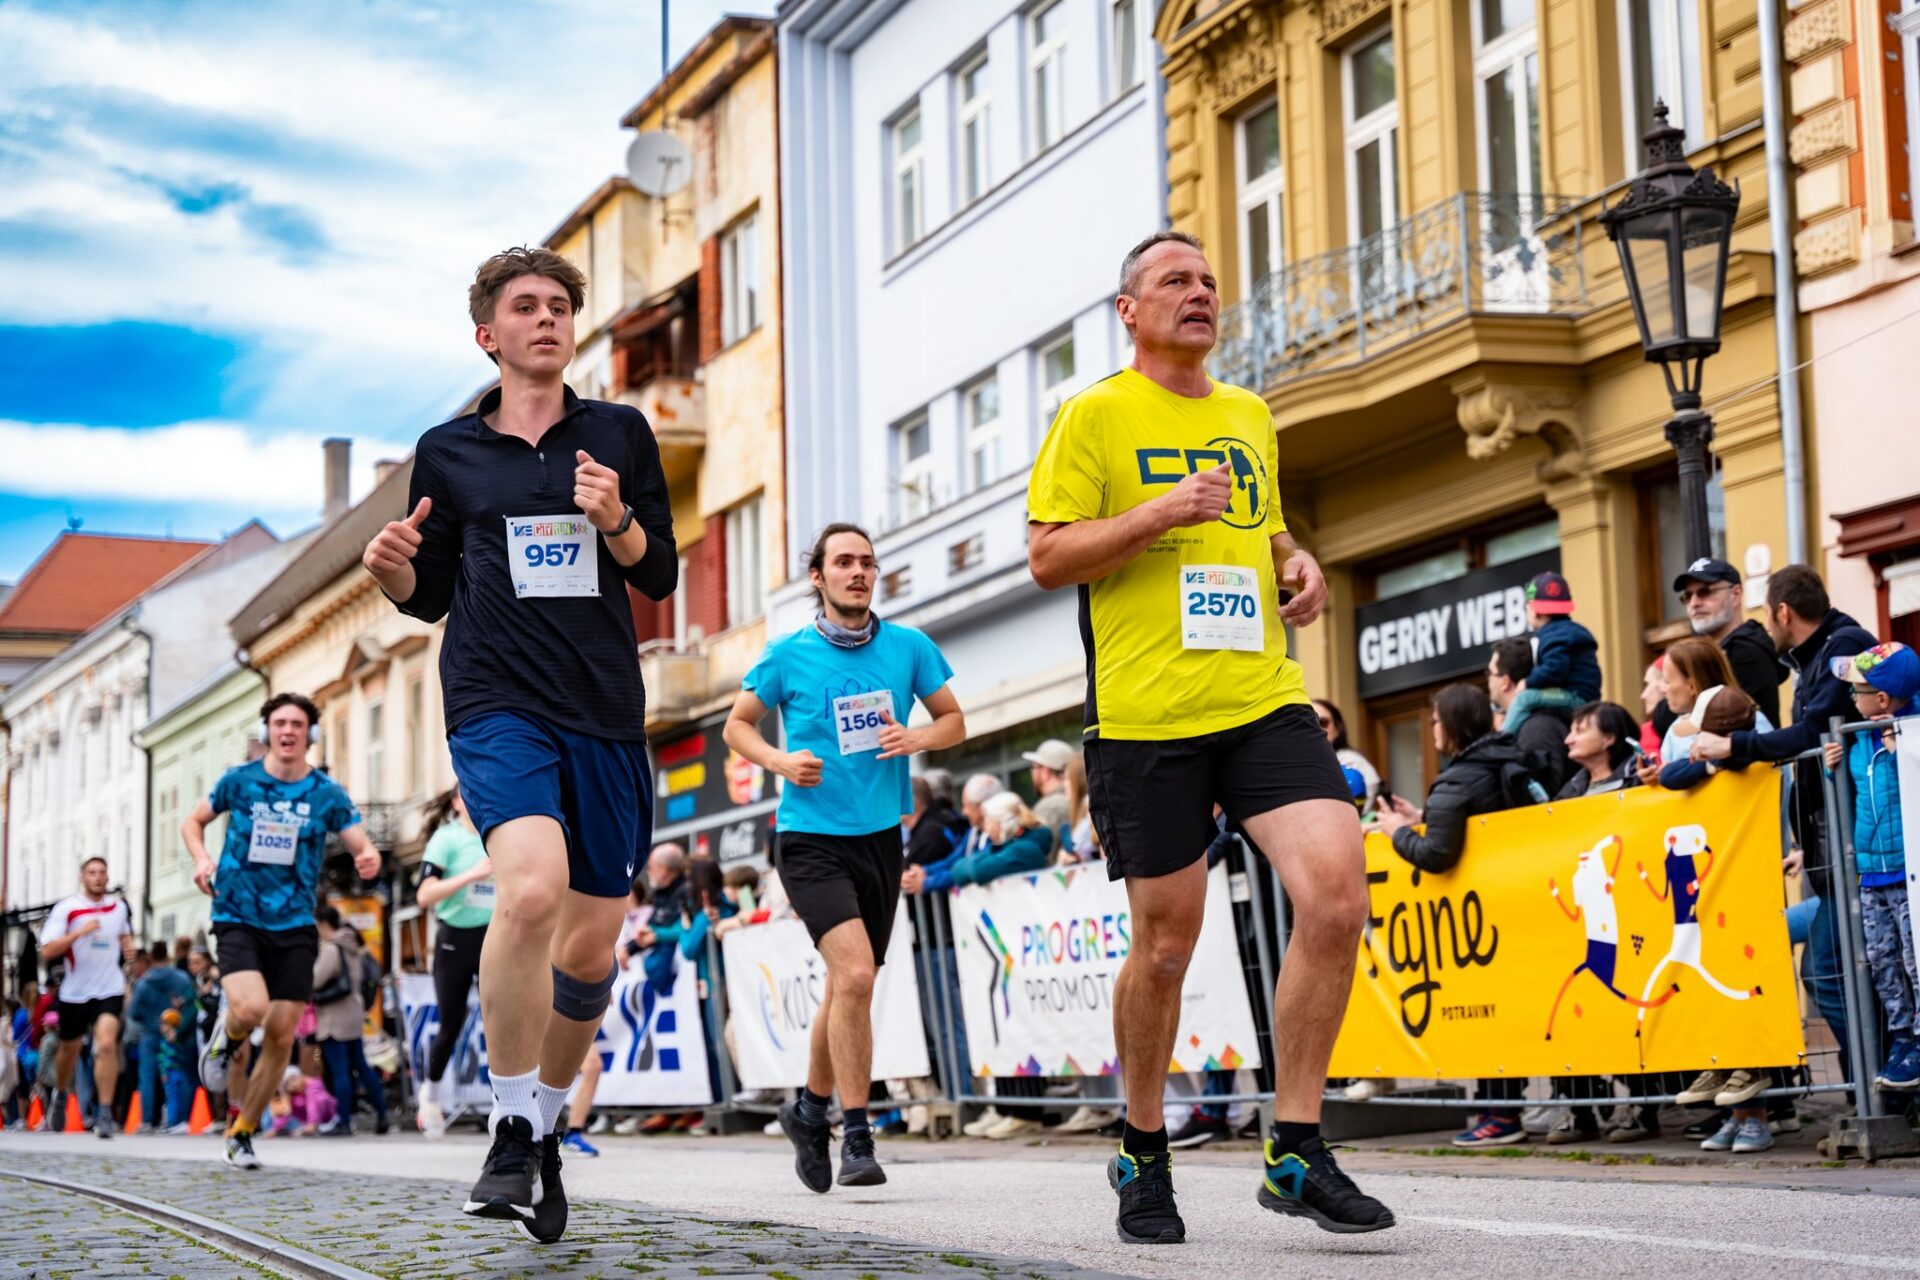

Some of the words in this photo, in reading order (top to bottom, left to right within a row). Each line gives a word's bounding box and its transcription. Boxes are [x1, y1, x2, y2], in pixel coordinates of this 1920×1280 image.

[525, 543, 580, 567] 957
[1188, 591, 1256, 619] 2570
[1359, 604, 1452, 675] GERRY
[1456, 585, 1535, 649] WEB
[255, 834, 293, 850] 1025
[1022, 912, 1131, 966] PROGRES
[780, 957, 827, 1032] KOŠ
[1441, 1003, 1496, 1021] POTRAVINY
